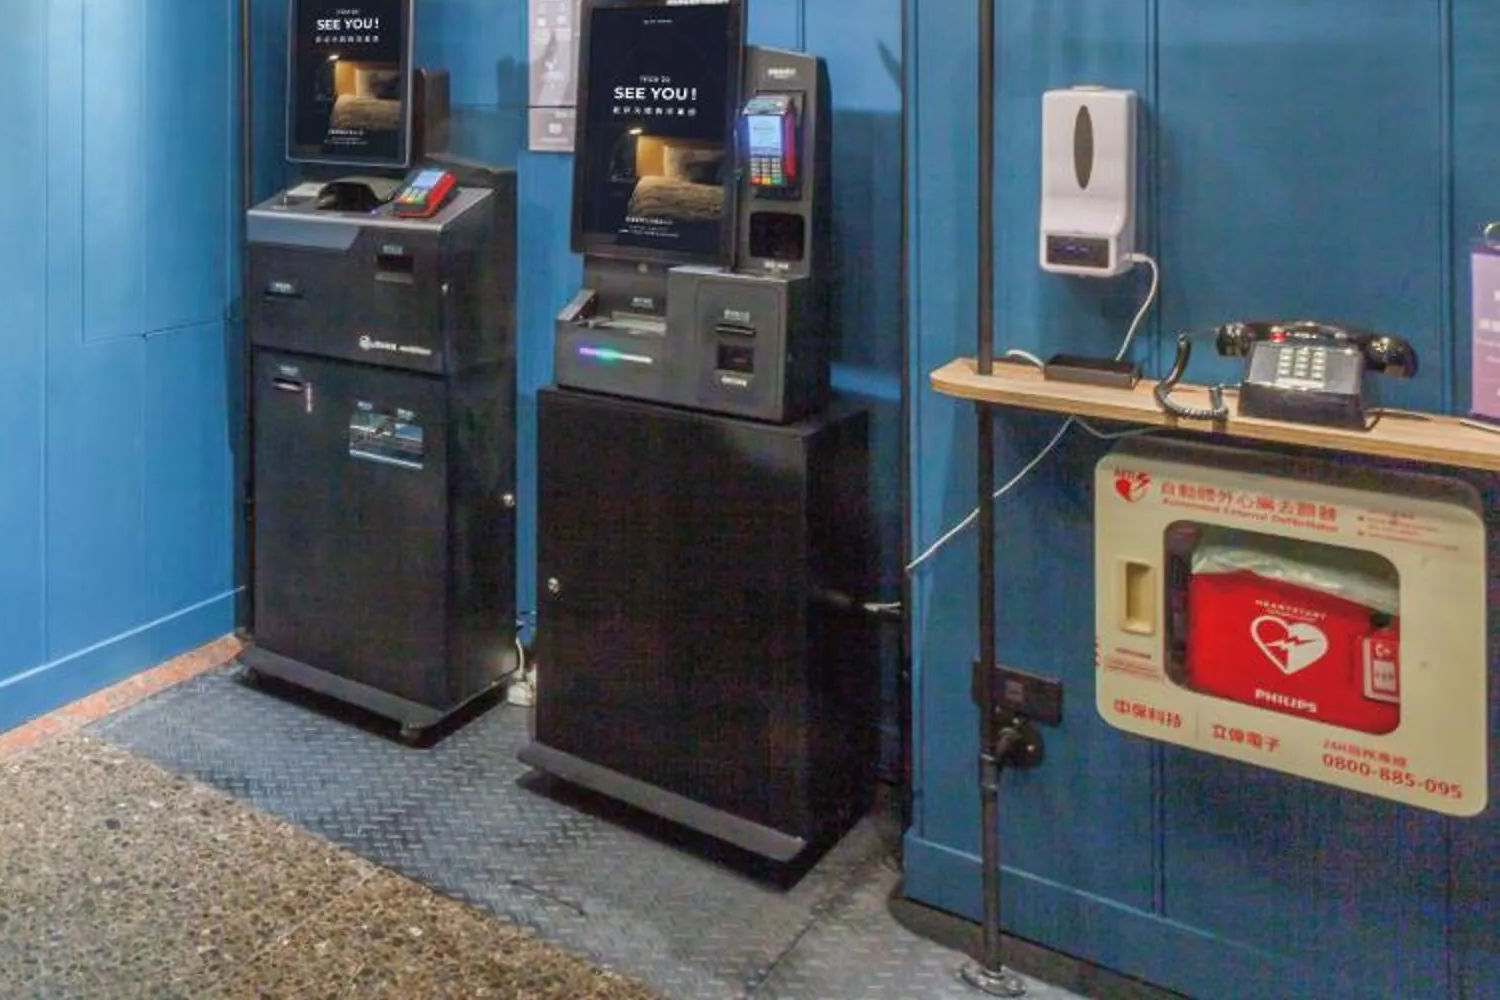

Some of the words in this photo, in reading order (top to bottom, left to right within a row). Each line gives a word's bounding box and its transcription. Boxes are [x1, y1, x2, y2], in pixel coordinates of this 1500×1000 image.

[316, 19, 341, 31] SEE
[613, 86, 646, 101] SEE
[1255, 688, 1318, 714] PHILIPS
[1321, 752, 1464, 800] 0800-885-095
